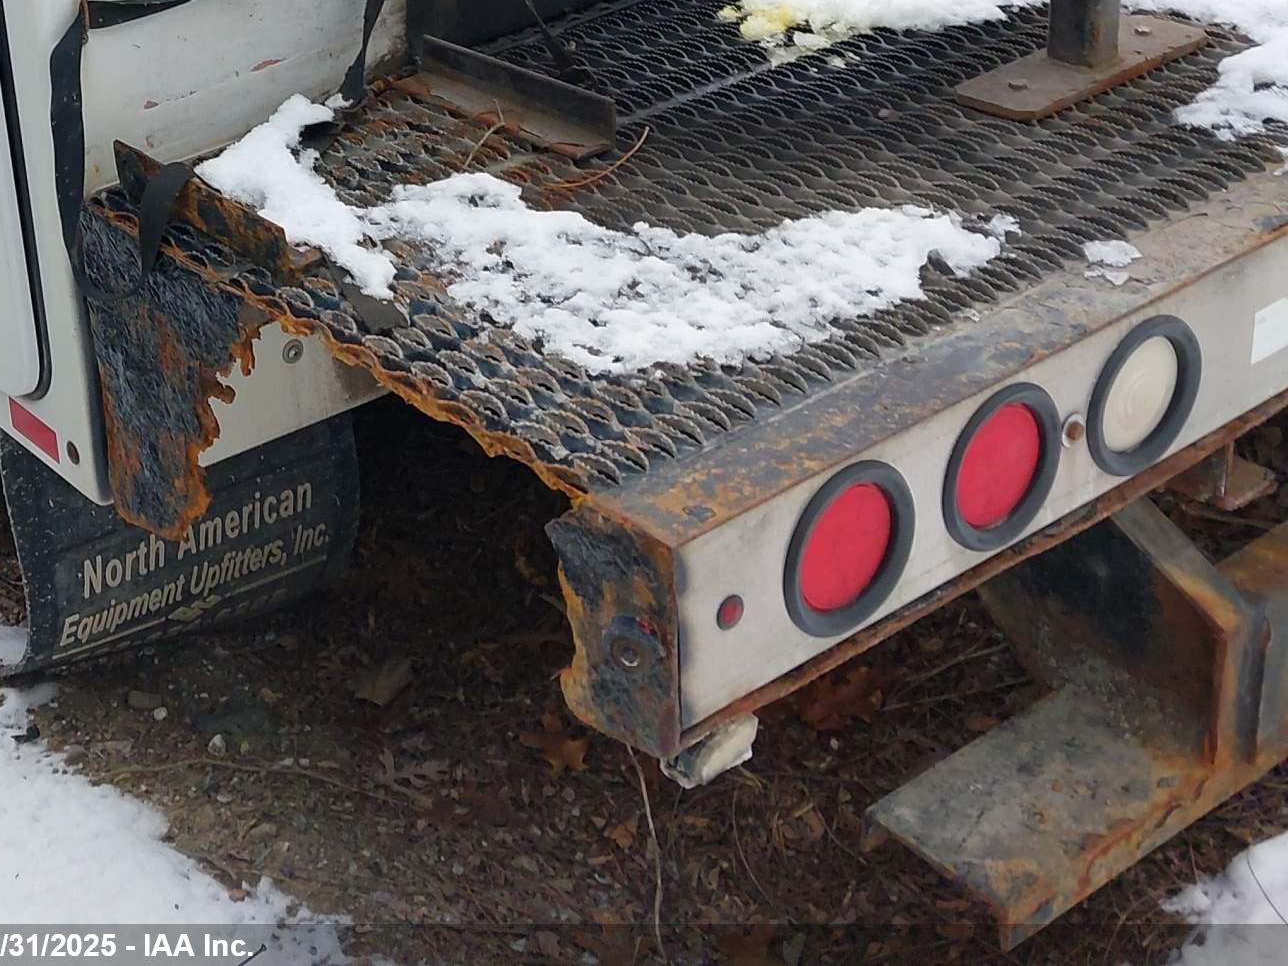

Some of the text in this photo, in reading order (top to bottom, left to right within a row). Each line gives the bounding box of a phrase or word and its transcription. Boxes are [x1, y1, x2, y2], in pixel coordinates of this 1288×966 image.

[59, 574, 186, 647] Equipment
[190, 537, 287, 596] Upfitters,
[293, 521, 329, 556] Inc.
[83, 482, 312, 599] North American
